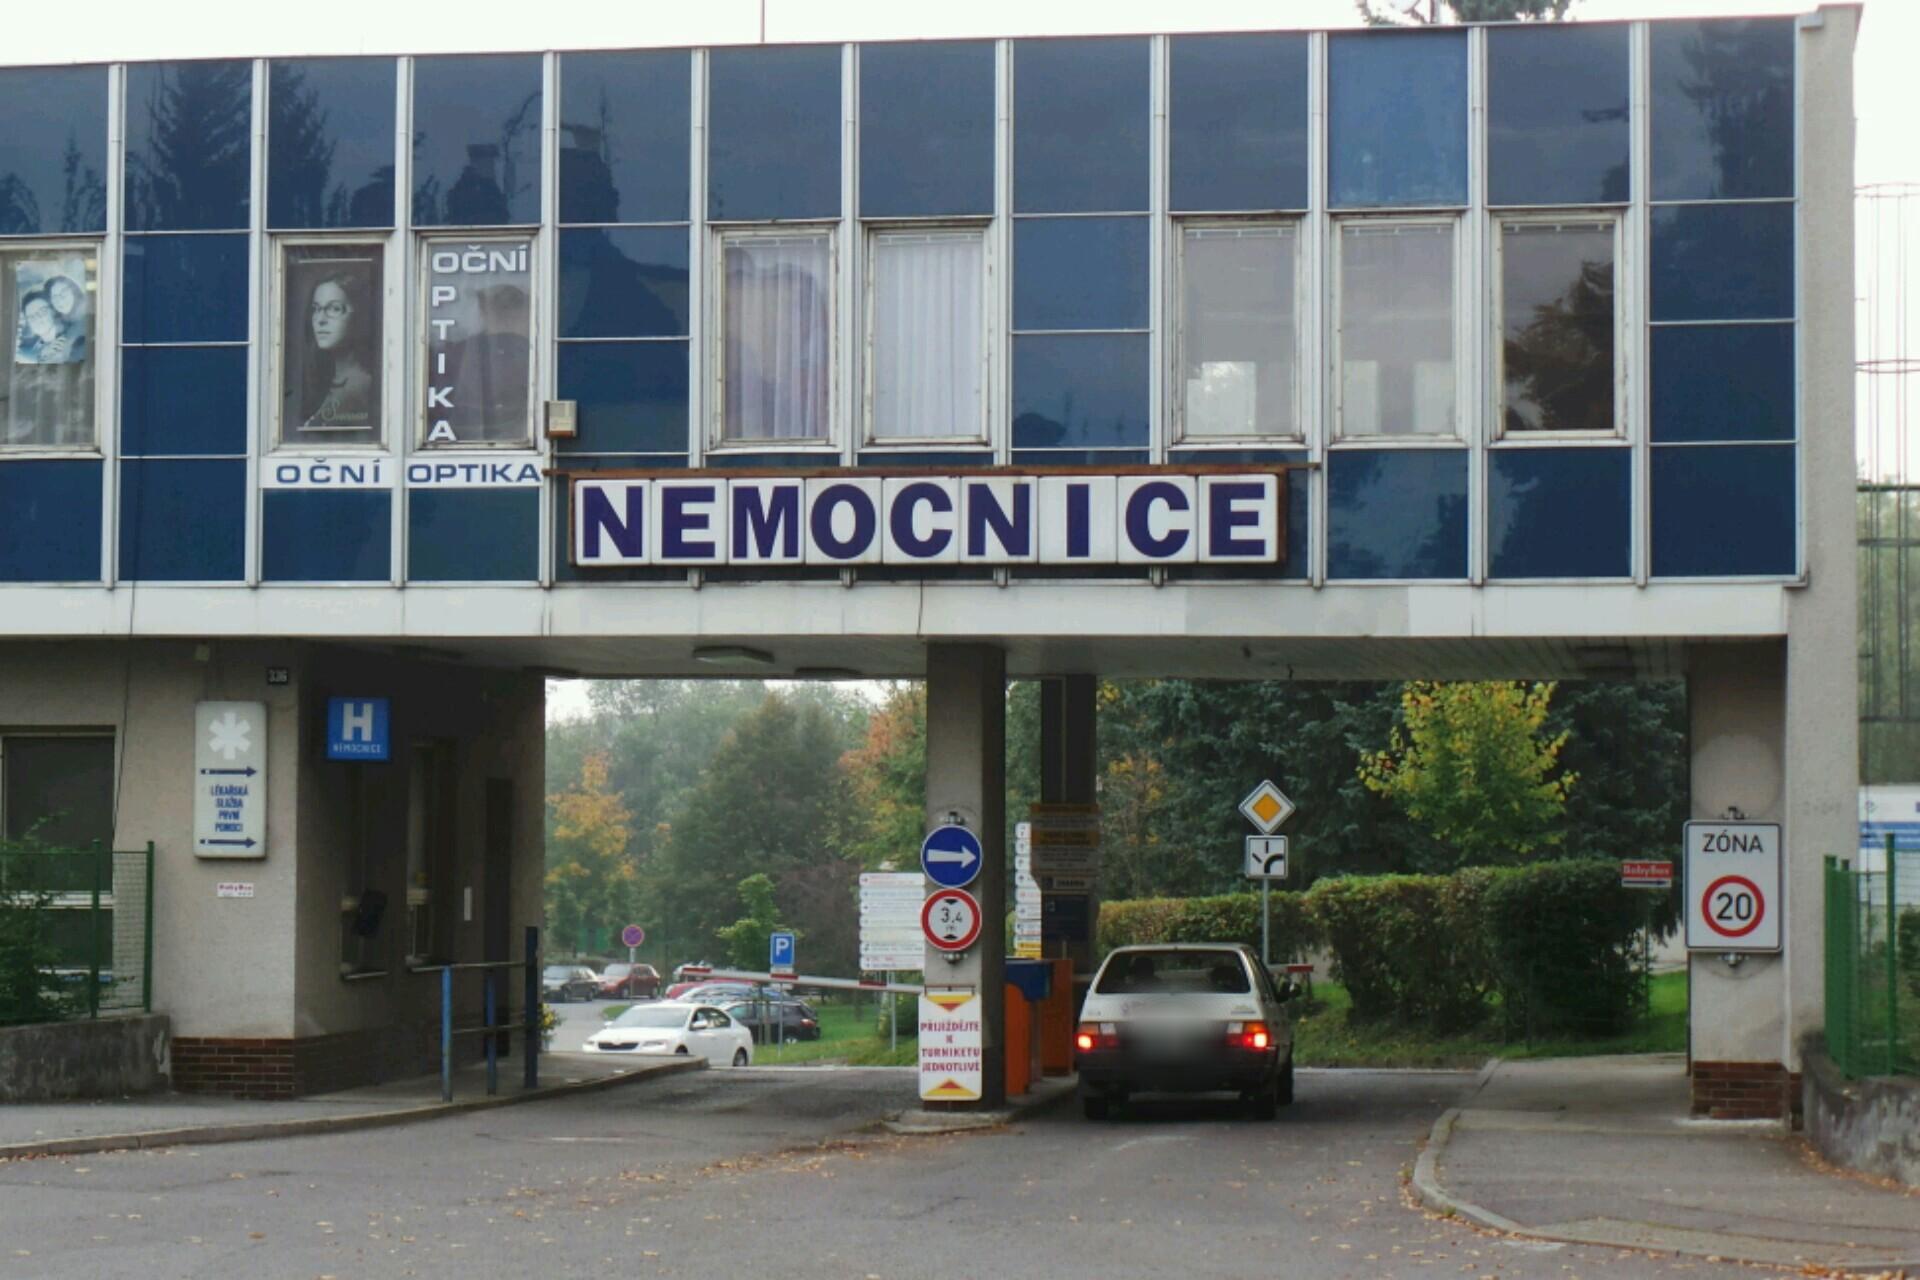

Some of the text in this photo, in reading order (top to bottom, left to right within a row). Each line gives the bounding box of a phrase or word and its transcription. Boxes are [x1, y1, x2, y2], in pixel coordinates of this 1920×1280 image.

[431, 244, 528, 273] OČNÍ
[275, 456, 542, 484] OČNÍ OPTIKA
[582, 481, 1268, 560] NEMOCNICE
[342, 703, 373, 741] H
[1702, 829, 1763, 853] ZÓNA
[1716, 892, 1752, 921] 20
[775, 937, 790, 957] P
